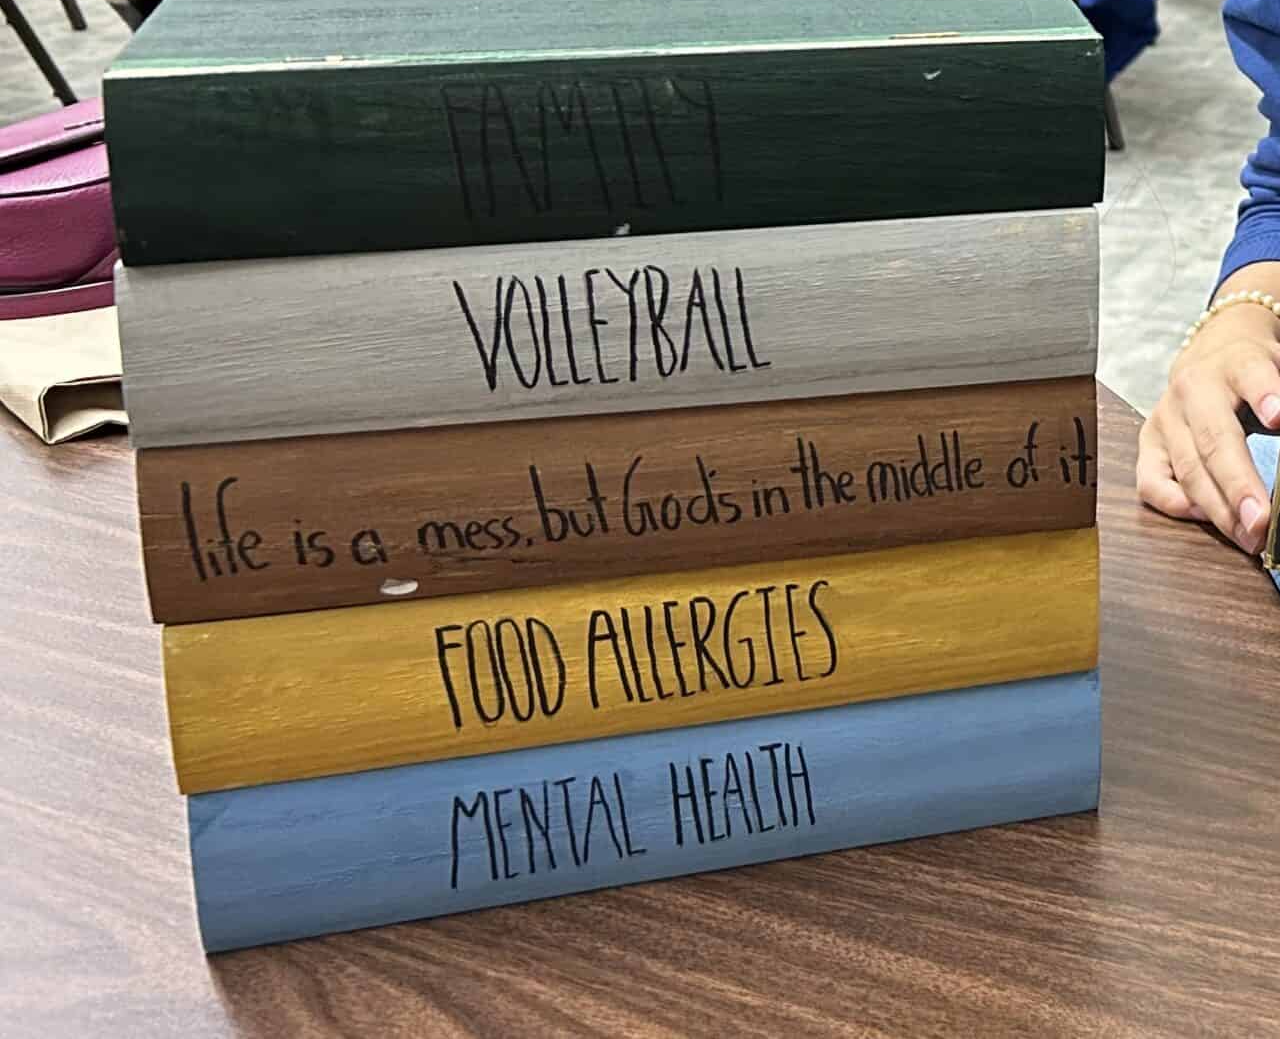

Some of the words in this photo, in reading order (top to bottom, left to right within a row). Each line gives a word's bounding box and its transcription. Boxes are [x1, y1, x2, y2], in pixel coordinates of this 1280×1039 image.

[441, 74, 724, 222] FAMILY
[452, 265, 772, 393] VOLLEYBALL
[181, 477, 270, 583] life
[293, 519, 336, 567] is
[352, 528, 389, 565] a
[528, 461, 610, 542] but
[751, 479, 790, 517] in
[790, 431, 855, 509] the
[866, 429, 984, 503] middle
[1006, 421, 1040, 488] of
[435, 617, 566, 729] FOOD
[587, 580, 838, 709] ALLERGIES
[450, 772, 647, 890] MENTAL
[670, 742, 816, 846] HEALTH
